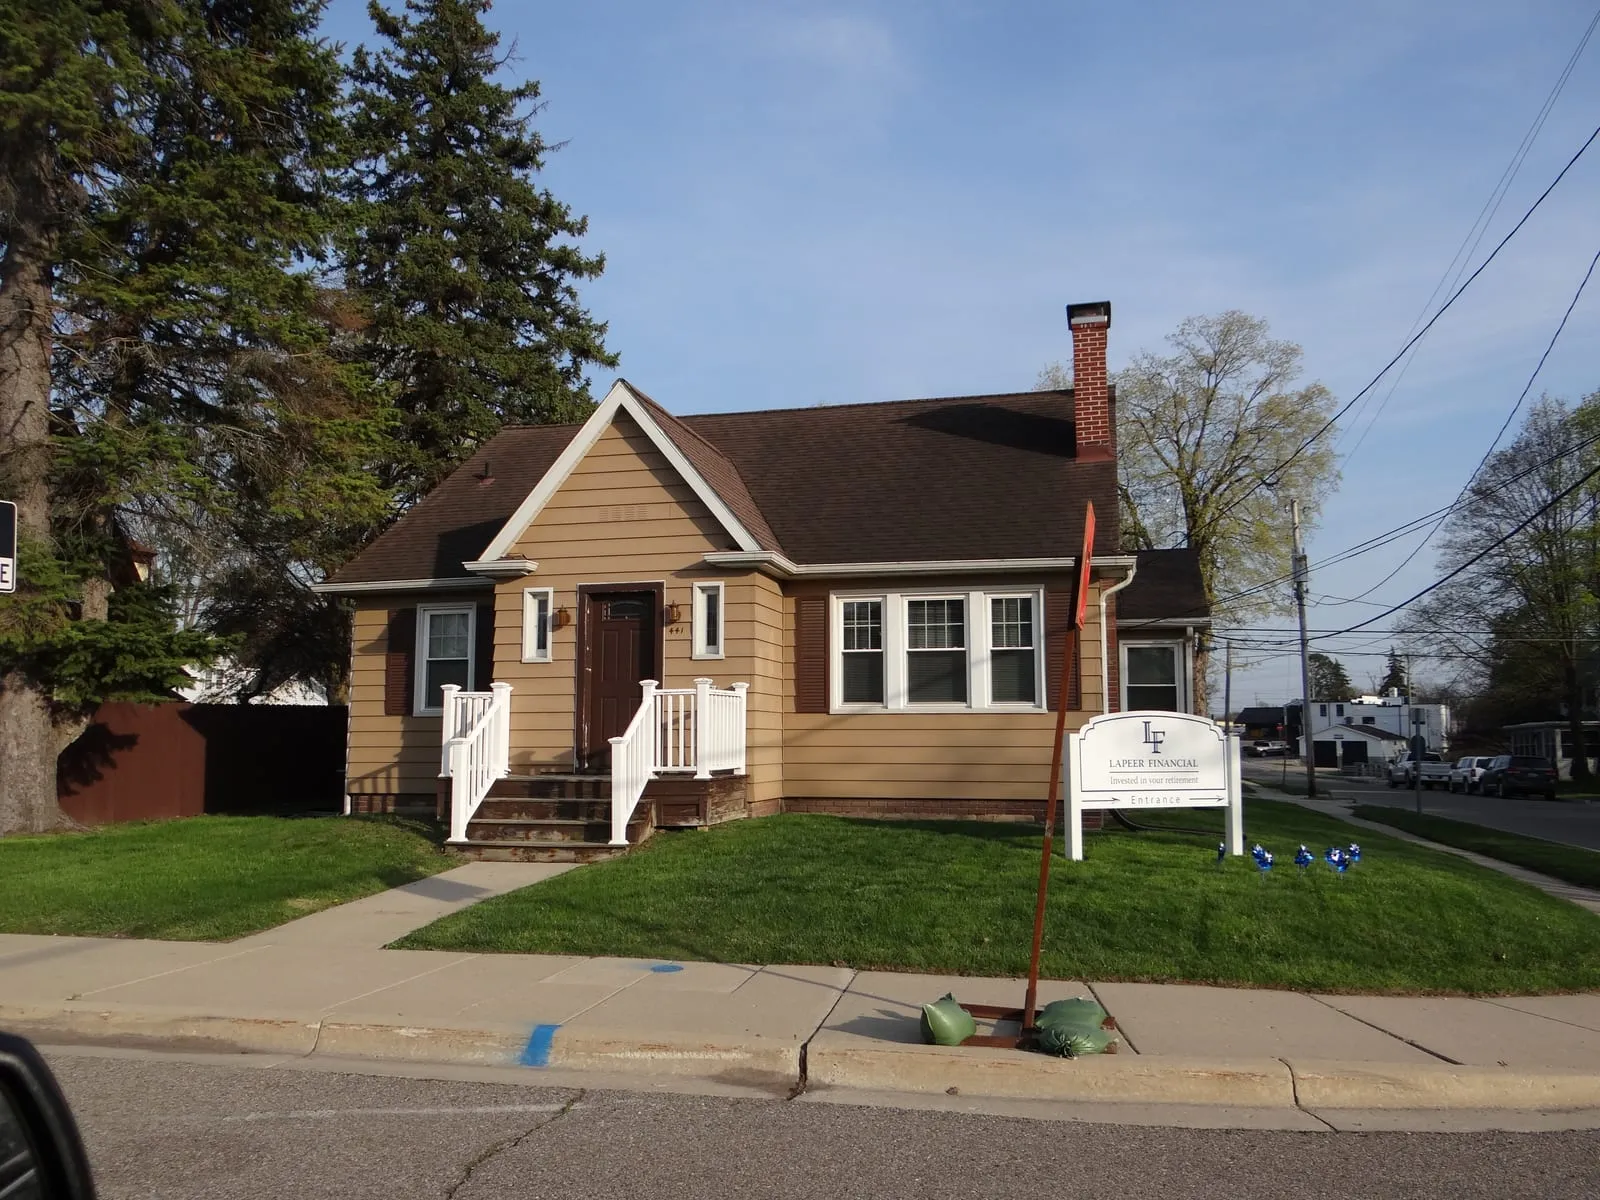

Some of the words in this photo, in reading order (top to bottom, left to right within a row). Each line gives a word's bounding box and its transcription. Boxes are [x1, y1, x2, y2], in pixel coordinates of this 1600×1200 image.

[1109, 759, 1145, 768] LAPEER
[1148, 759, 1199, 768] FINANCIAL
[1110, 776, 1139, 785] Invested
[1149, 777, 1164, 786] your
[1165, 775, 1199, 784] retirement
[1131, 795, 1181, 805] Entrance
